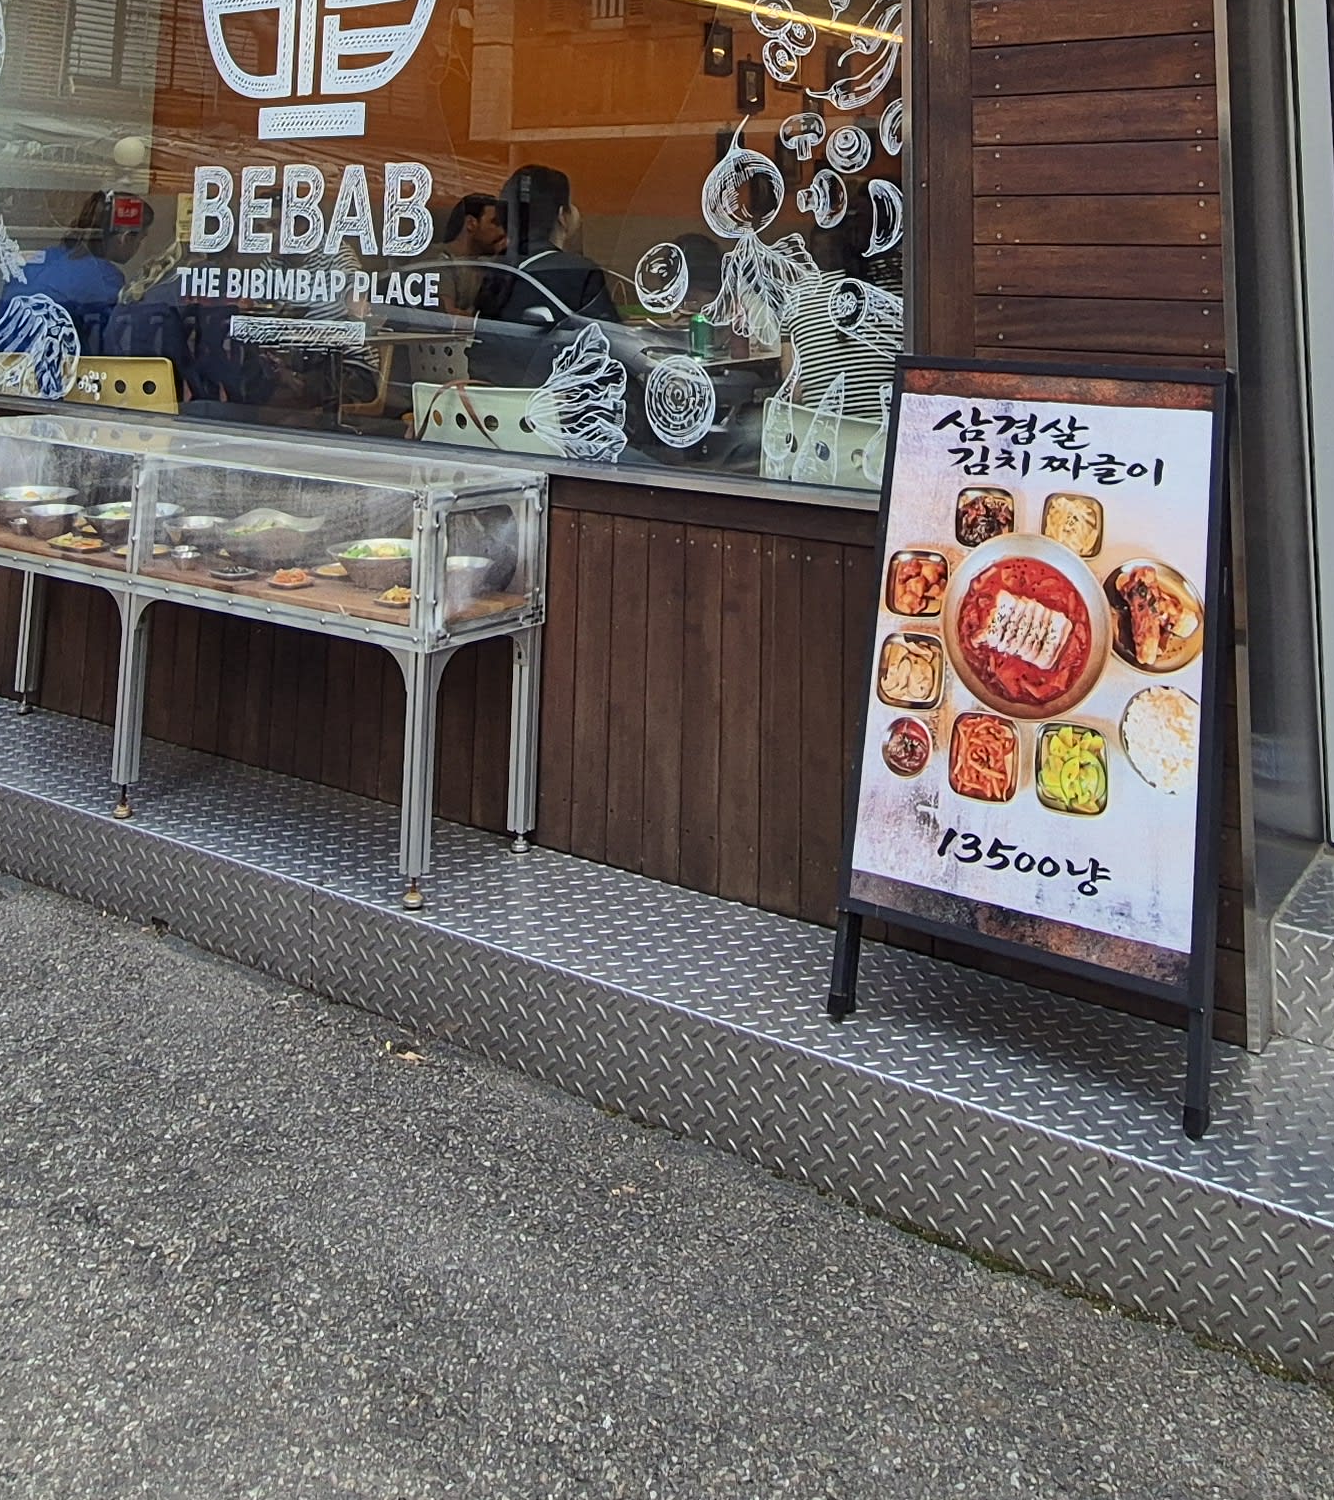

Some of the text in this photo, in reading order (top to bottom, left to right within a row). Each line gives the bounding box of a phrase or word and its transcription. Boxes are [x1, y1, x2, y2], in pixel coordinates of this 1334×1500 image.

[189, 162, 436, 258] BEBAB
[176, 266, 440, 308] THE BIBIMBAP PLACE
[932, 406, 1091, 451] 삼겹살
[947, 445, 1165, 487] 김치 짜글이
[936, 827, 1116, 897] 13500냥
